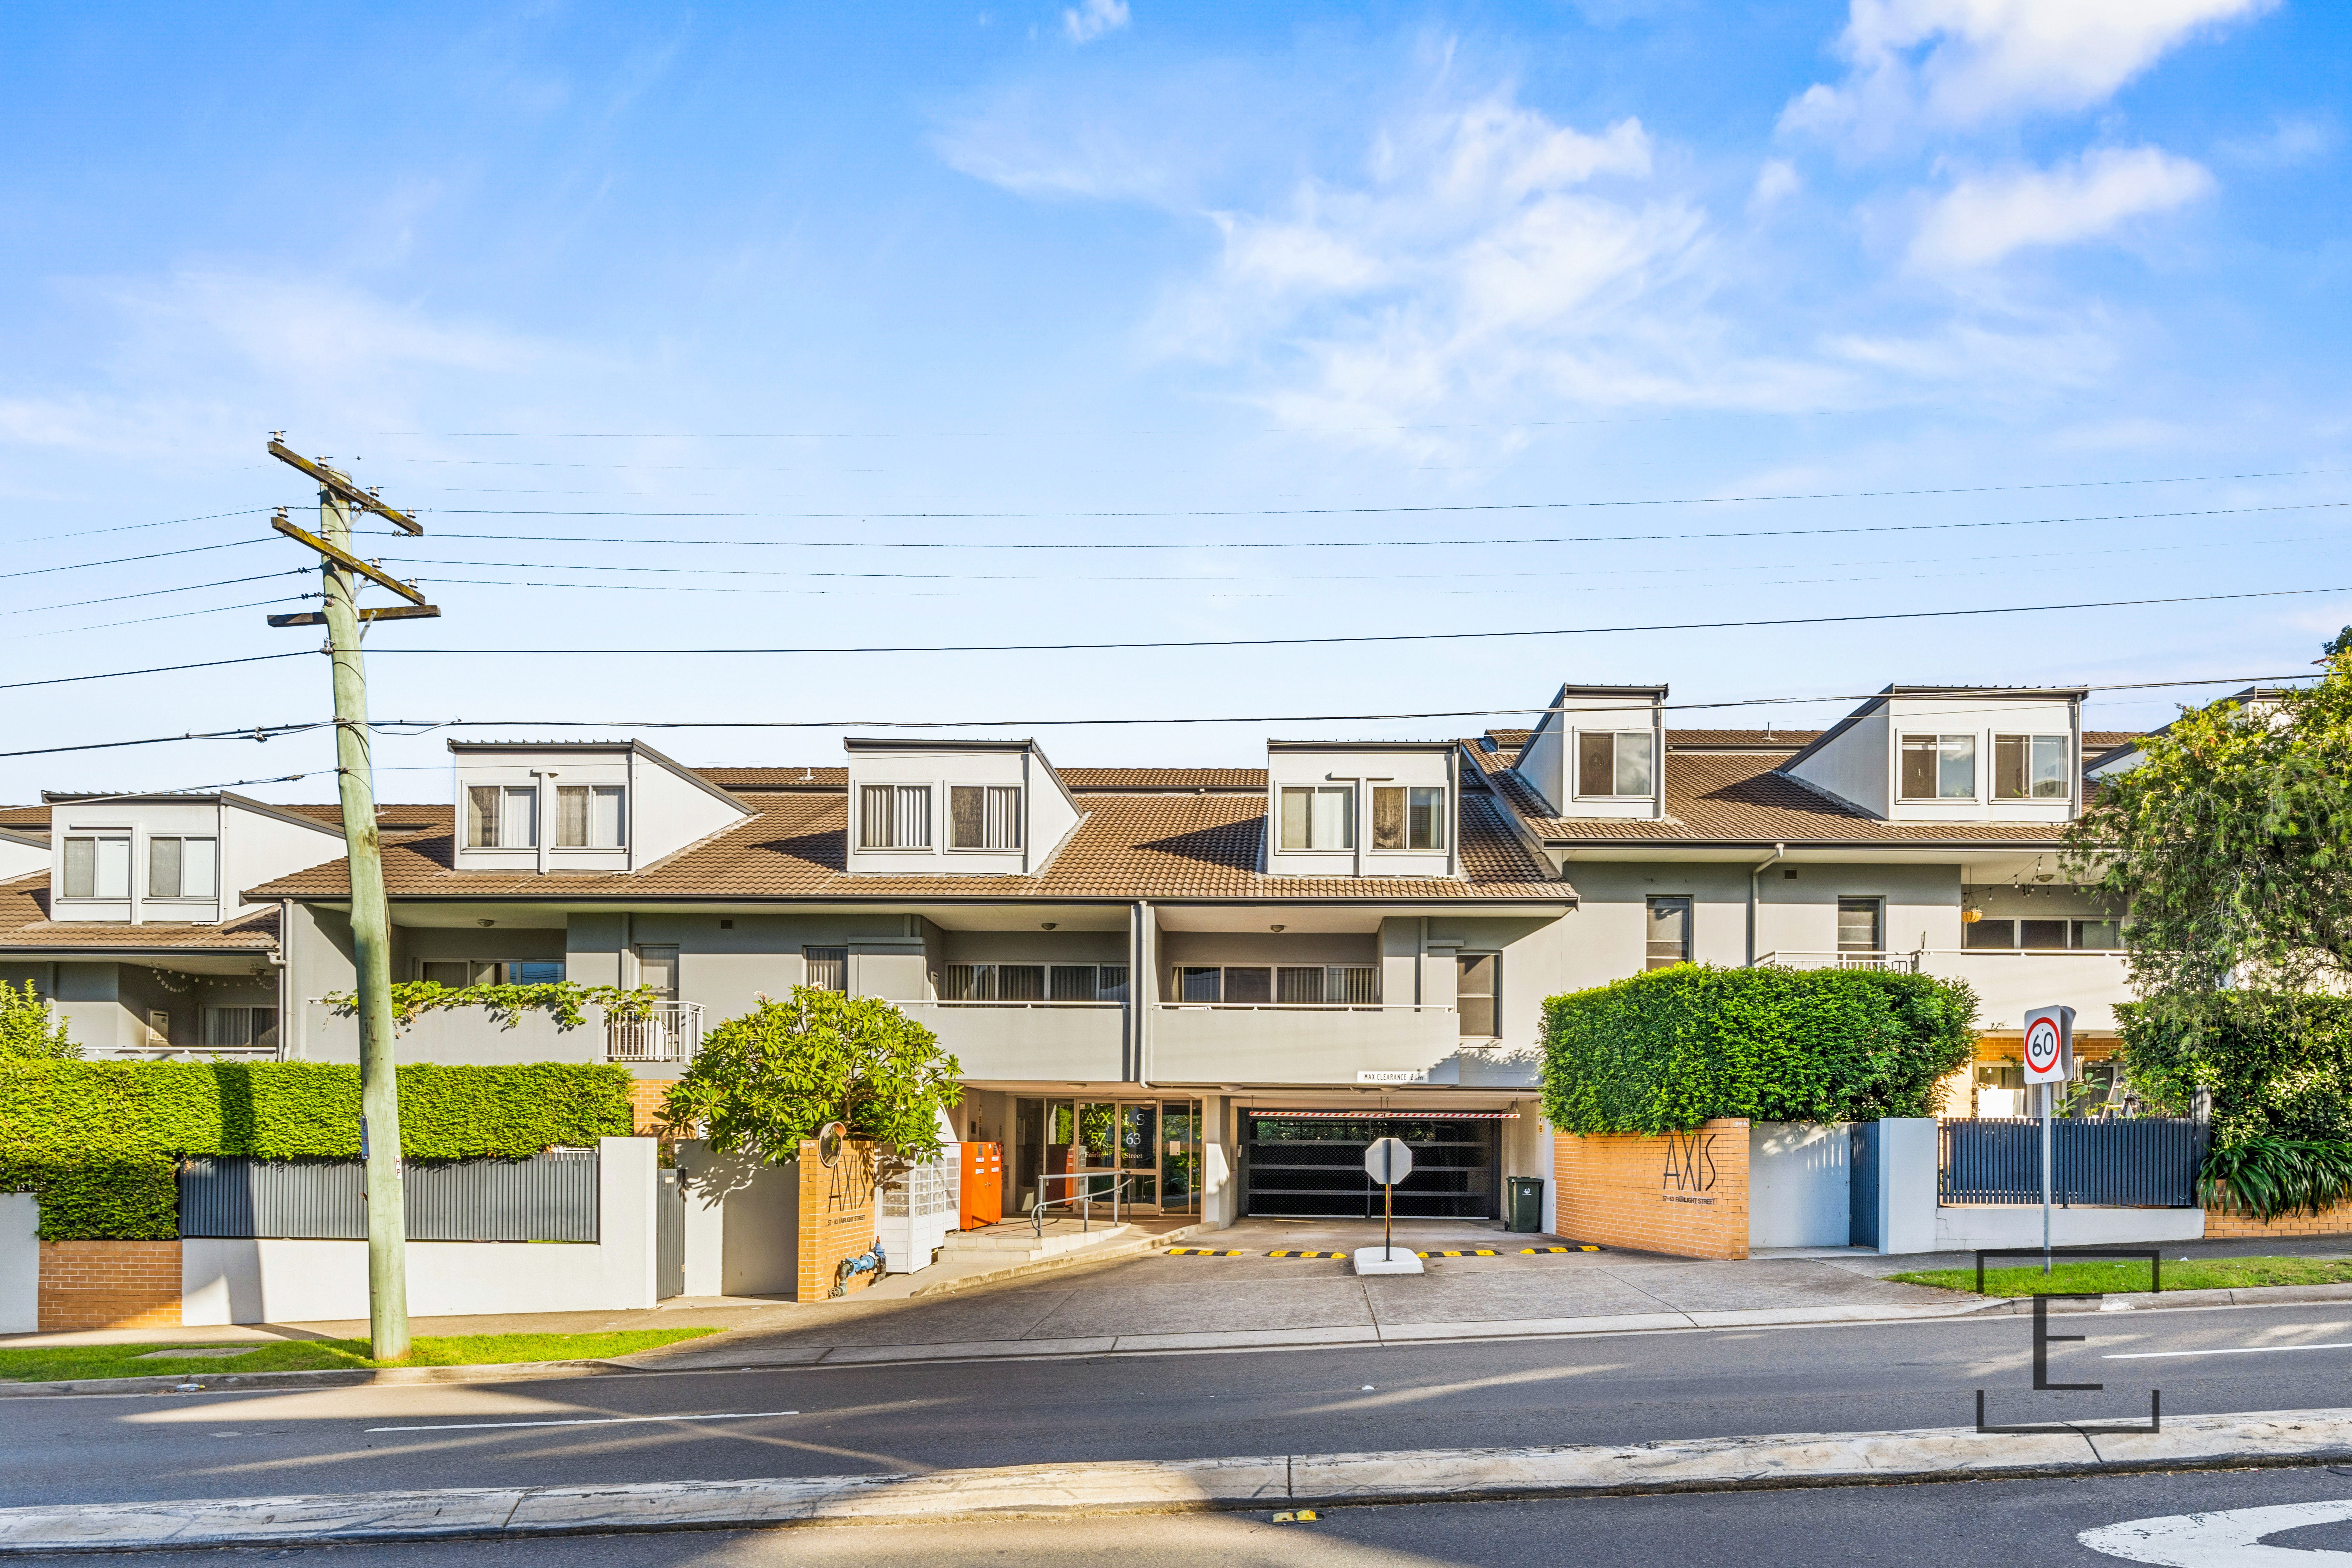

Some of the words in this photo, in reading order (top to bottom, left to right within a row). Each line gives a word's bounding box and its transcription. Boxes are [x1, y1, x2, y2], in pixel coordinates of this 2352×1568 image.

[2033, 1032, 2053, 1057] 60
[1090, 1132, 1106, 1144] 57
[1126, 1133, 1141, 1145] 63
[1663, 1134, 1716, 1192] AXIS
[829, 1155, 865, 1213] AXIS
